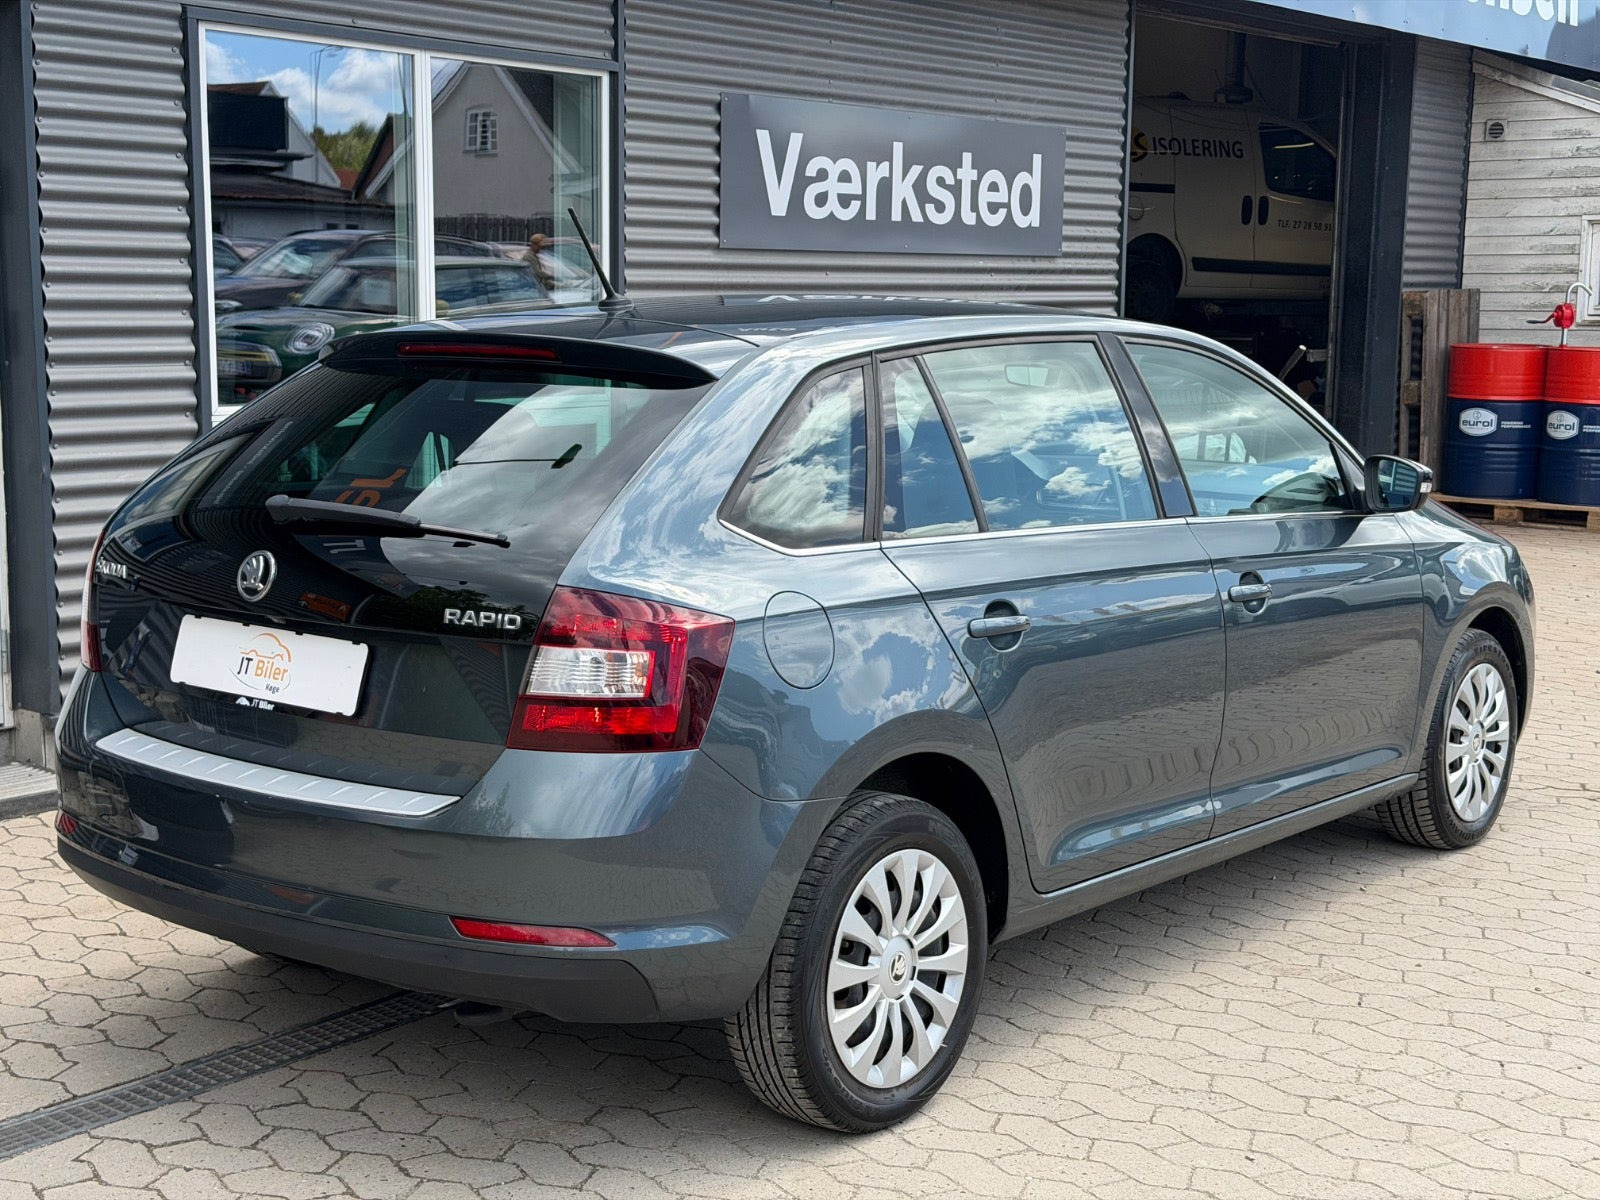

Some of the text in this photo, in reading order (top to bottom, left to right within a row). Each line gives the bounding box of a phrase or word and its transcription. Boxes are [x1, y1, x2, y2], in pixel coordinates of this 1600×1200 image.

[1152, 136, 1245, 159] ISOLERING
[756, 128, 1042, 228] Værksted
[1462, 418, 1493, 428] eurol
[1548, 422, 1576, 431] eurol
[443, 607, 521, 630] RAPID
[237, 656, 288, 682] JT Biler
